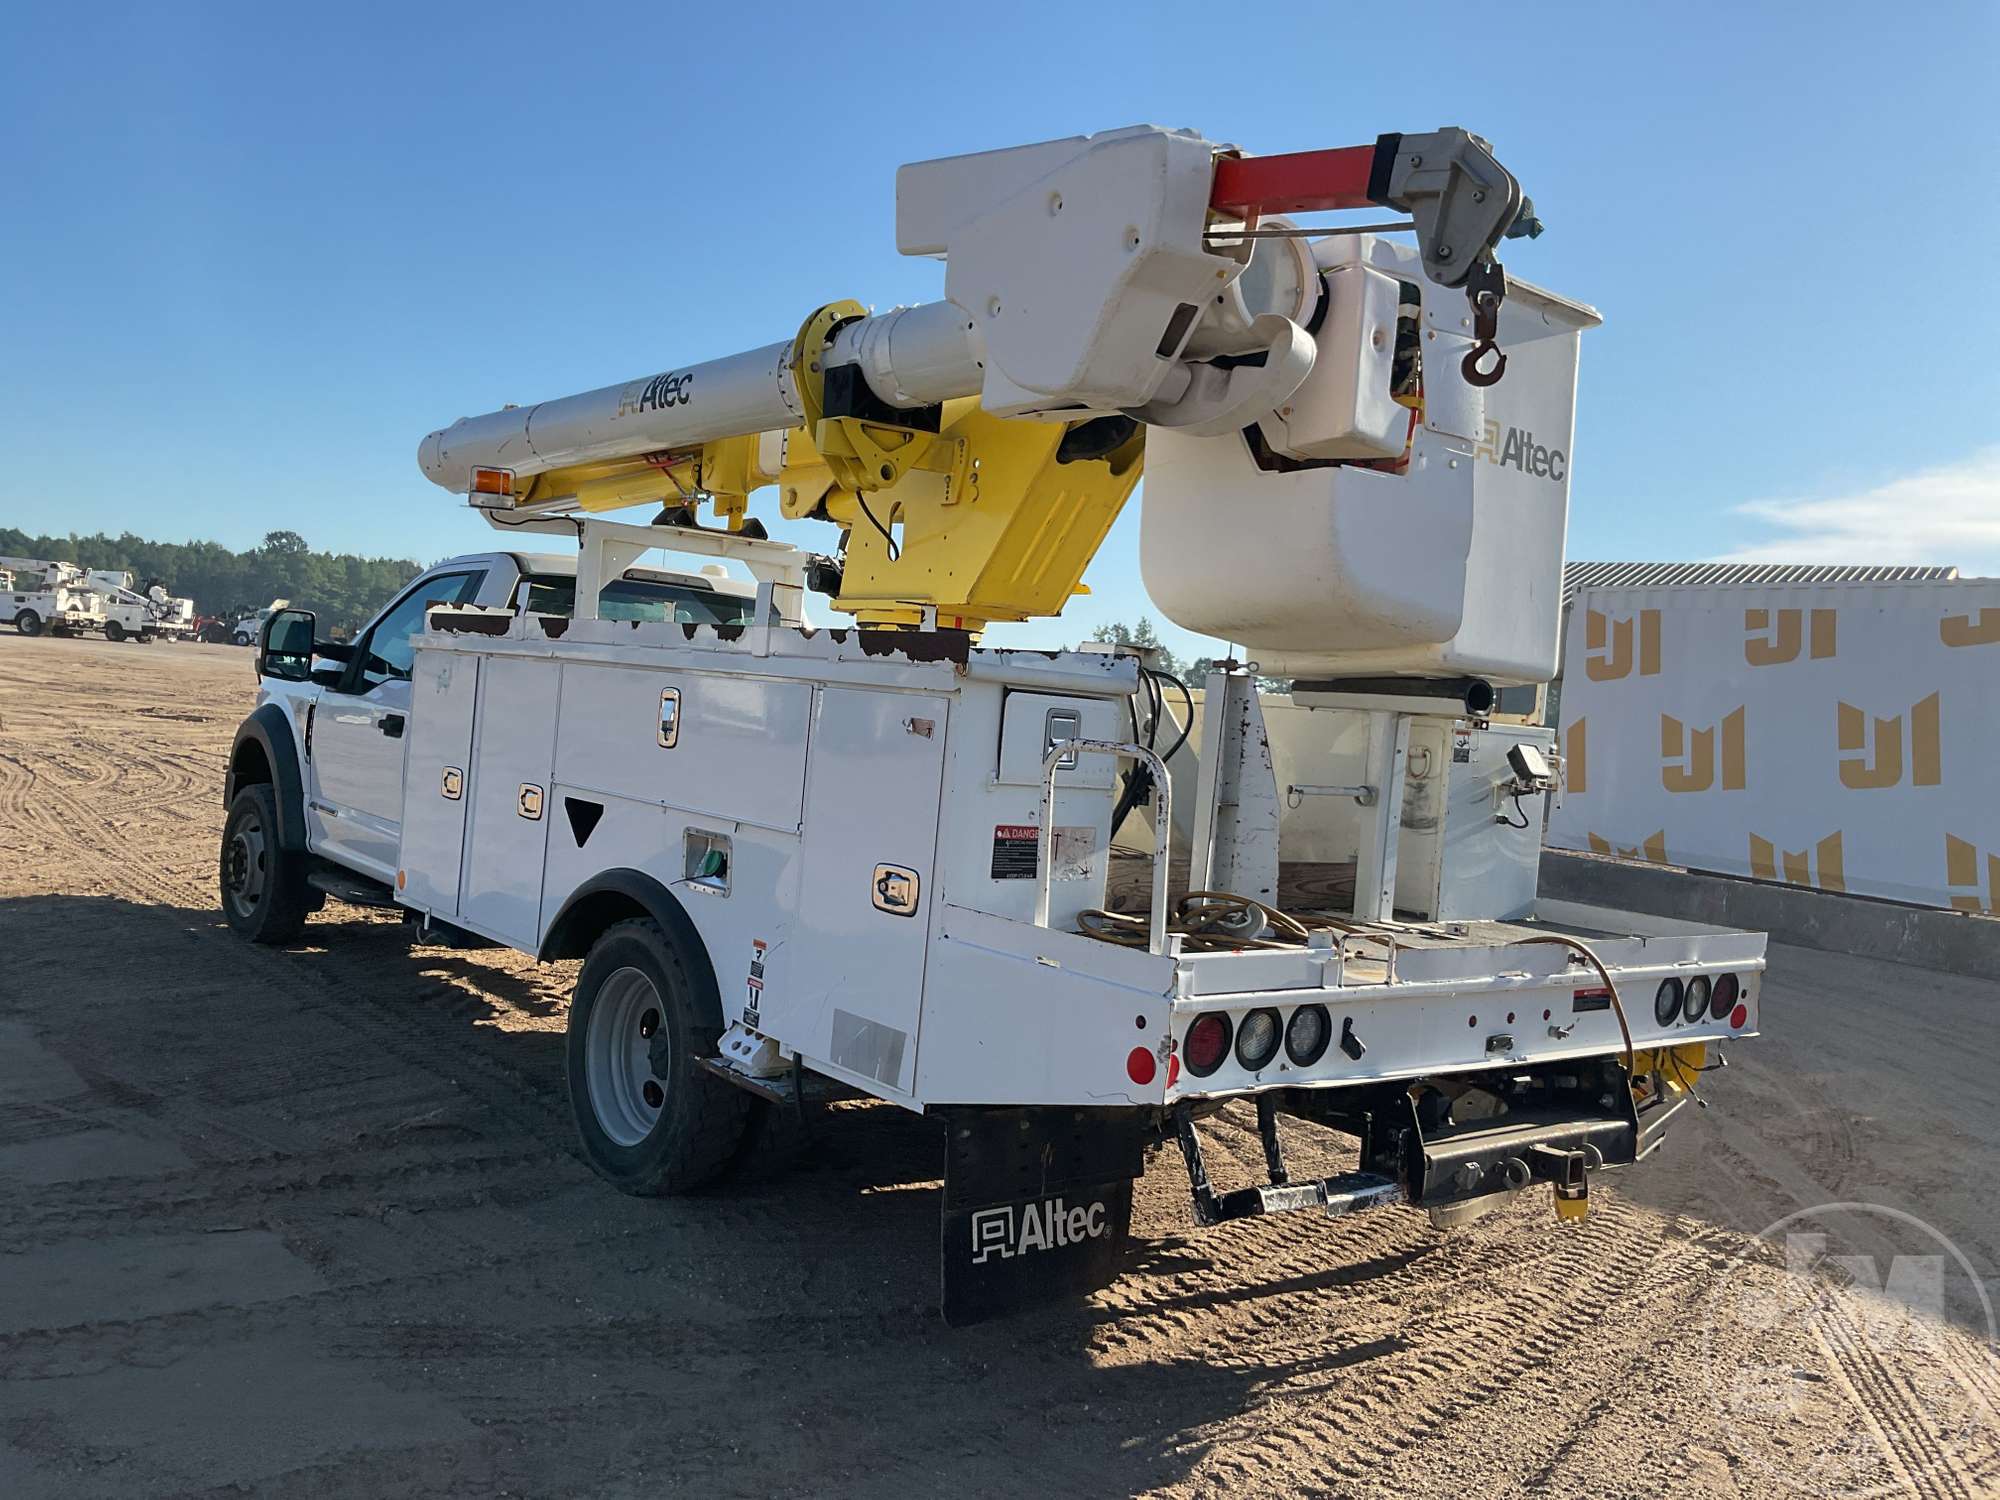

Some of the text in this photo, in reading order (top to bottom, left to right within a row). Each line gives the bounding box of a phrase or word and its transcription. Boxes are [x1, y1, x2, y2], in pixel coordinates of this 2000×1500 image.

[639, 372, 693, 413] Altec
[1499, 427, 1565, 482] Altec
[1012, 828, 1040, 839] DANGE
[1017, 1198, 1106, 1255] Altec
